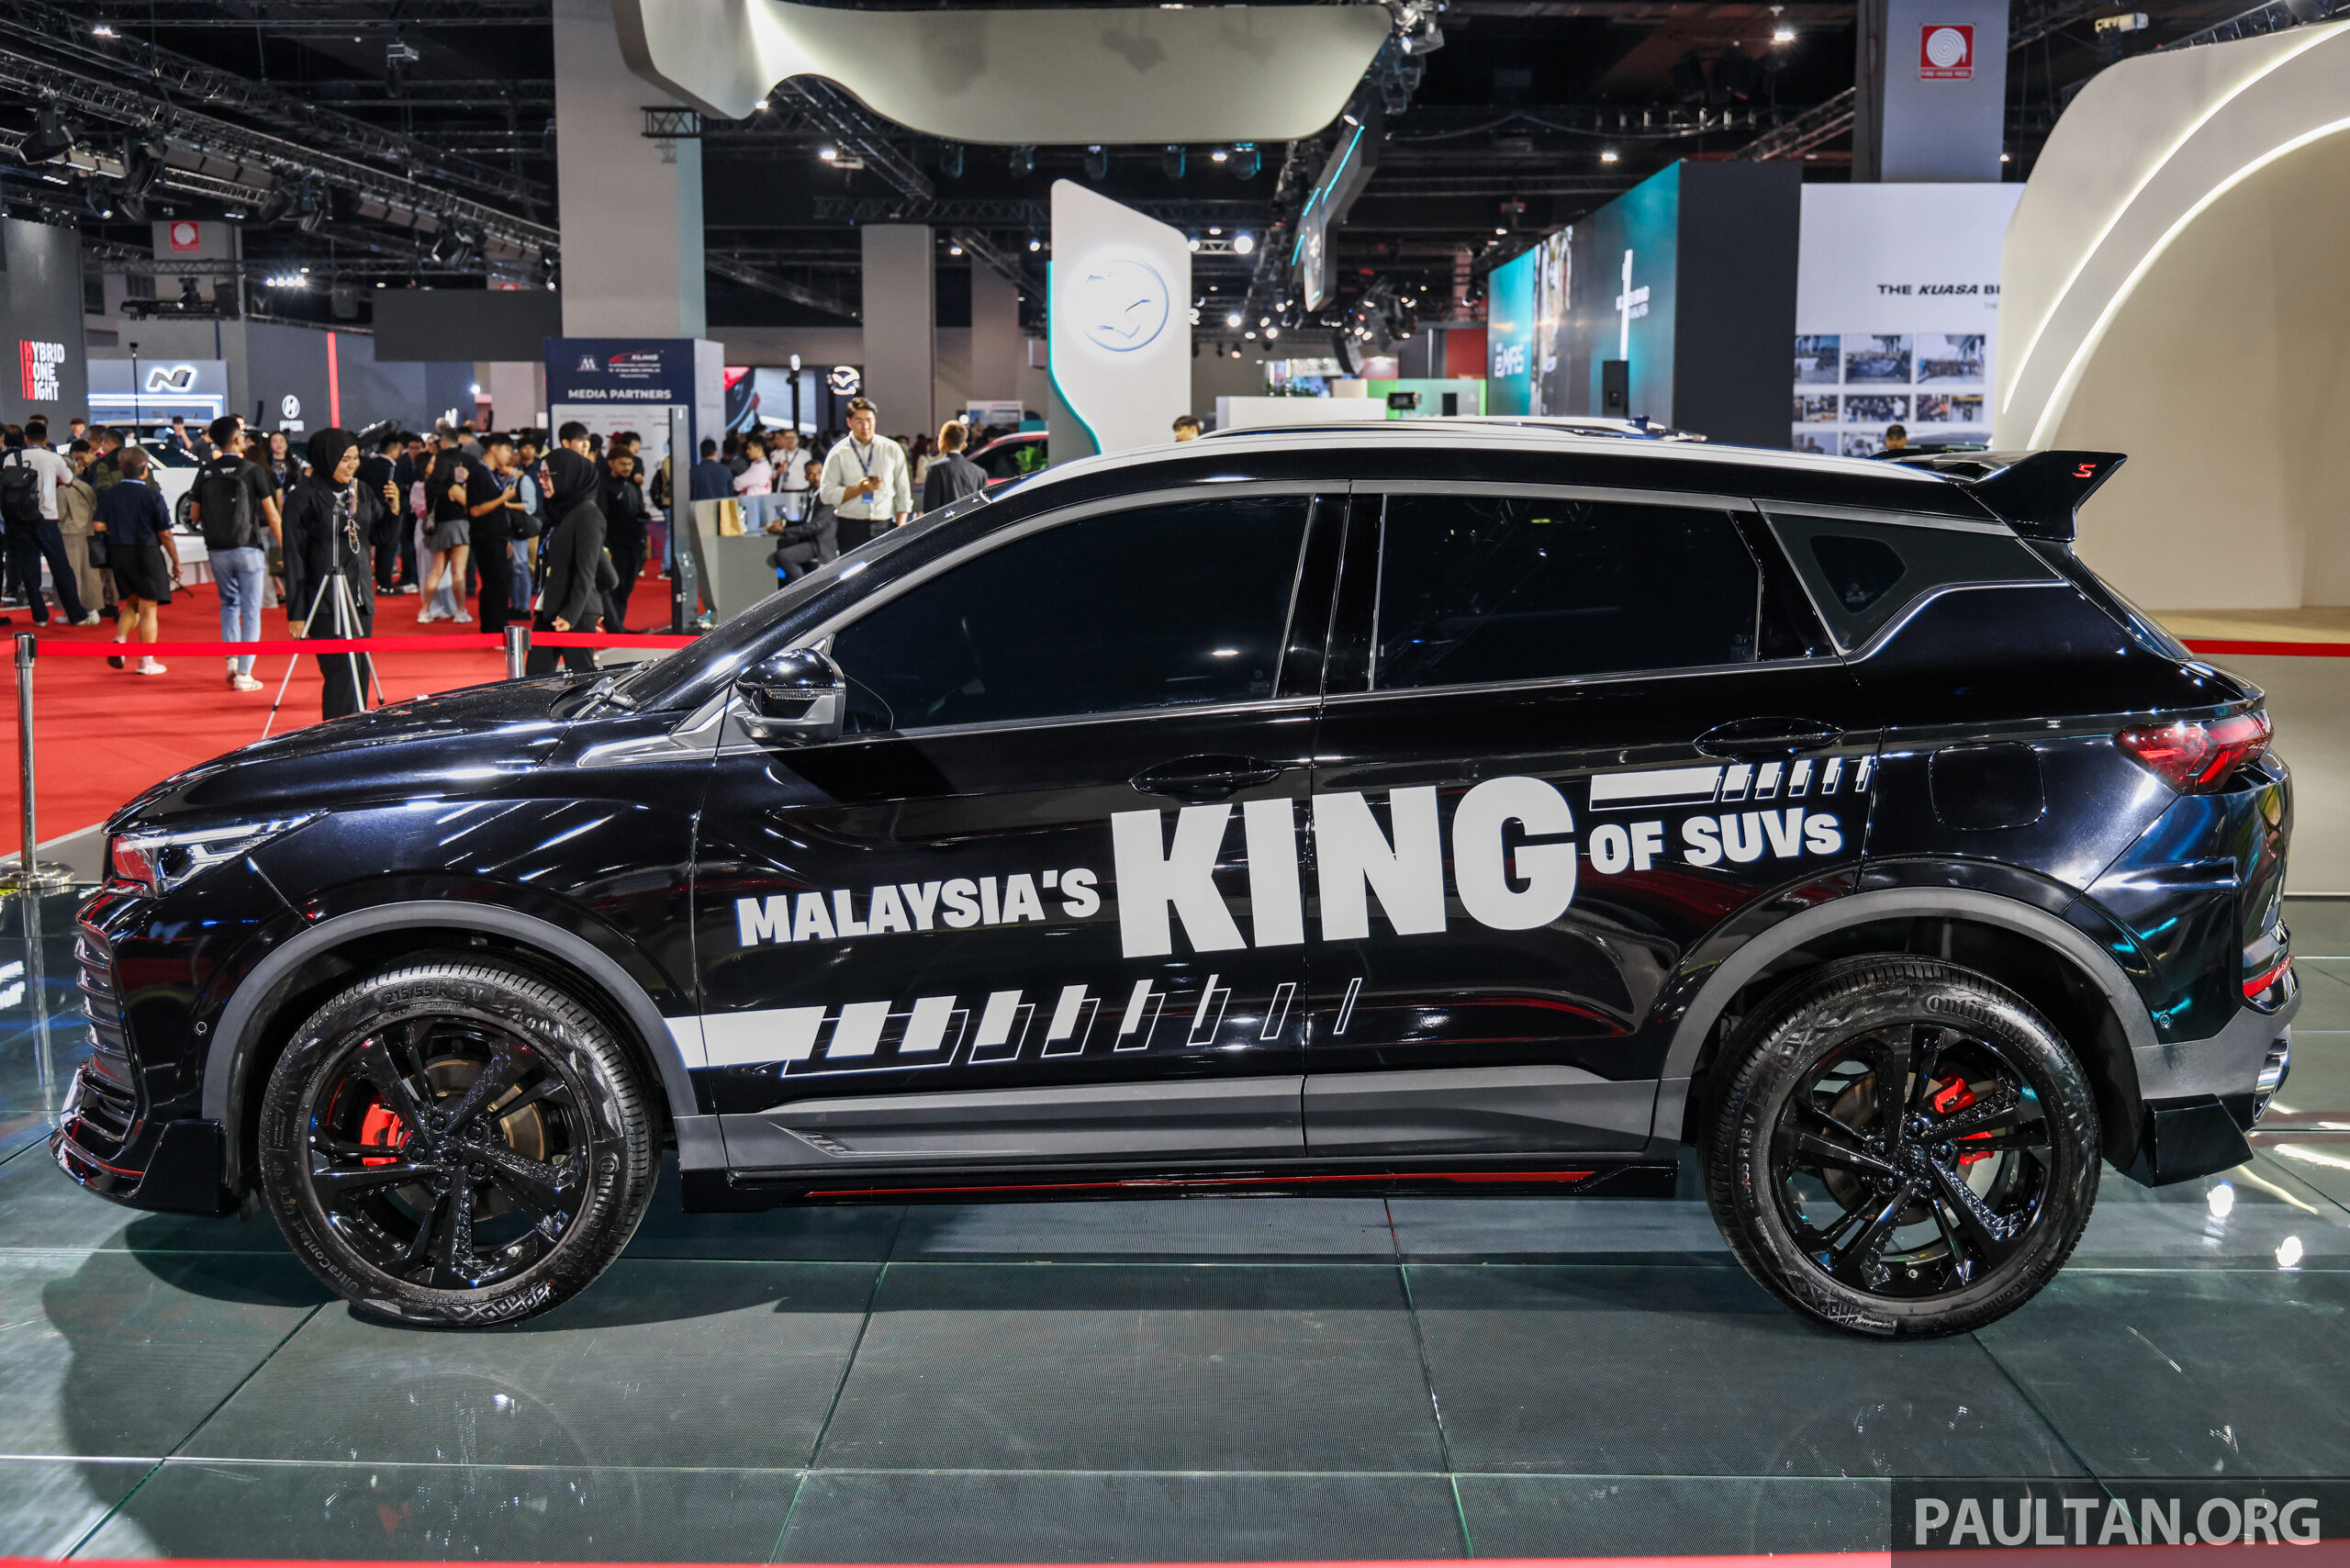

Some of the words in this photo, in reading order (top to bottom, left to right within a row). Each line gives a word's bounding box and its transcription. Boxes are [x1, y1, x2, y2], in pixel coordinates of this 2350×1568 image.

[1877, 285, 1911, 295] THE
[1919, 285, 1978, 295] KUASA
[24, 341, 66, 364] HYBRID
[26, 361, 57, 381] DONE
[27, 380, 60, 401] RIGHT
[568, 389, 608, 398] MEDIA
[610, 389, 672, 399] PARTNERS
[736, 868, 1102, 947] MALAYSIA'S
[1112, 777, 1577, 958] KING
[1589, 820, 1664, 875] OF
[1681, 807, 1843, 867] SUVs
[385, 985, 432, 1004] 215/55
[1921, 992, 2040, 1048] Continental
